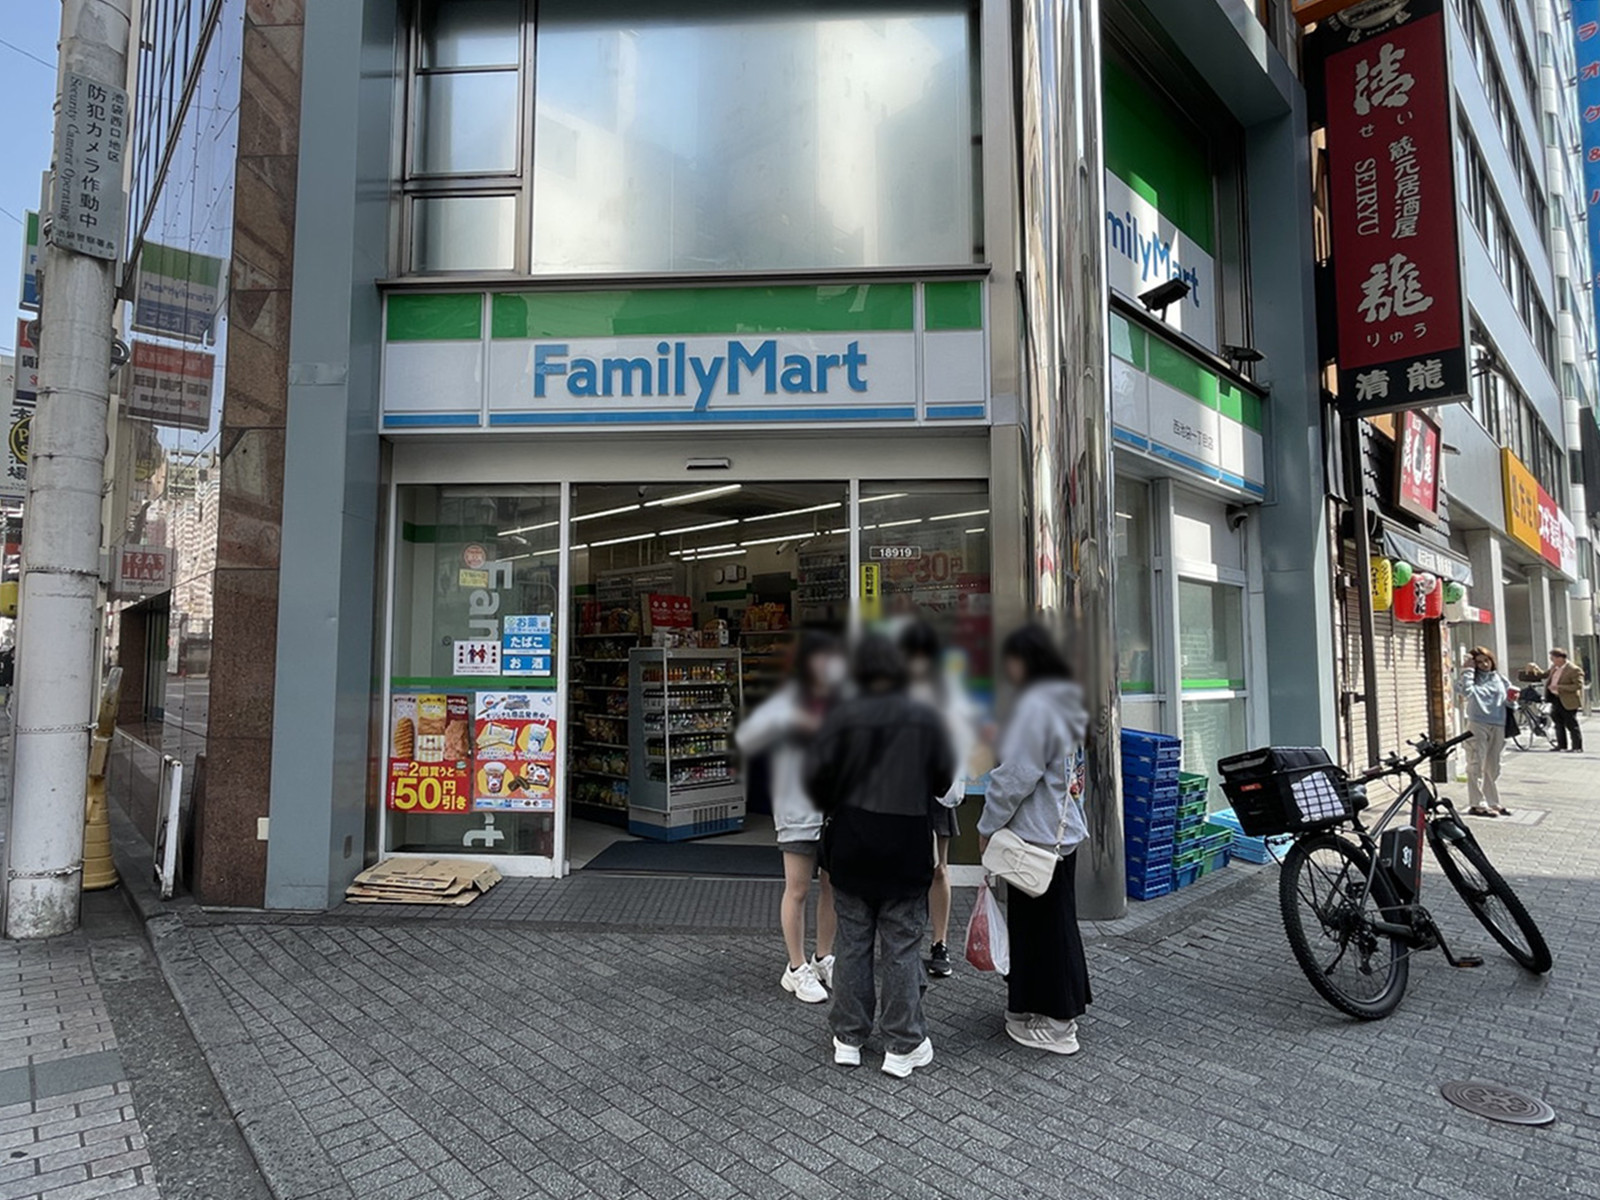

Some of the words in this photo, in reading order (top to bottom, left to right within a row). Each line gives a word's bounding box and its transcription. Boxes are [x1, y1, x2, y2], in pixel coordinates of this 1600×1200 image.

[65, 76, 82, 121] Security
[63, 124, 81, 165] Camera
[79, 83, 108, 229] 防犯カメラ作動中
[59, 168, 76, 223] Operating
[1354, 158, 1379, 236] SEIRYU
[1388, 136, 1421, 239] 蔵元居酒屋
[1367, 322, 1428, 348] りゅう
[534, 340, 868, 412] FamilyMart
[1355, 358, 1445, 401] 清龍
[879, 548, 912, 558] 18919
[510, 636, 543, 648] たばこ
[408, 761, 455, 777] 2個買うと
